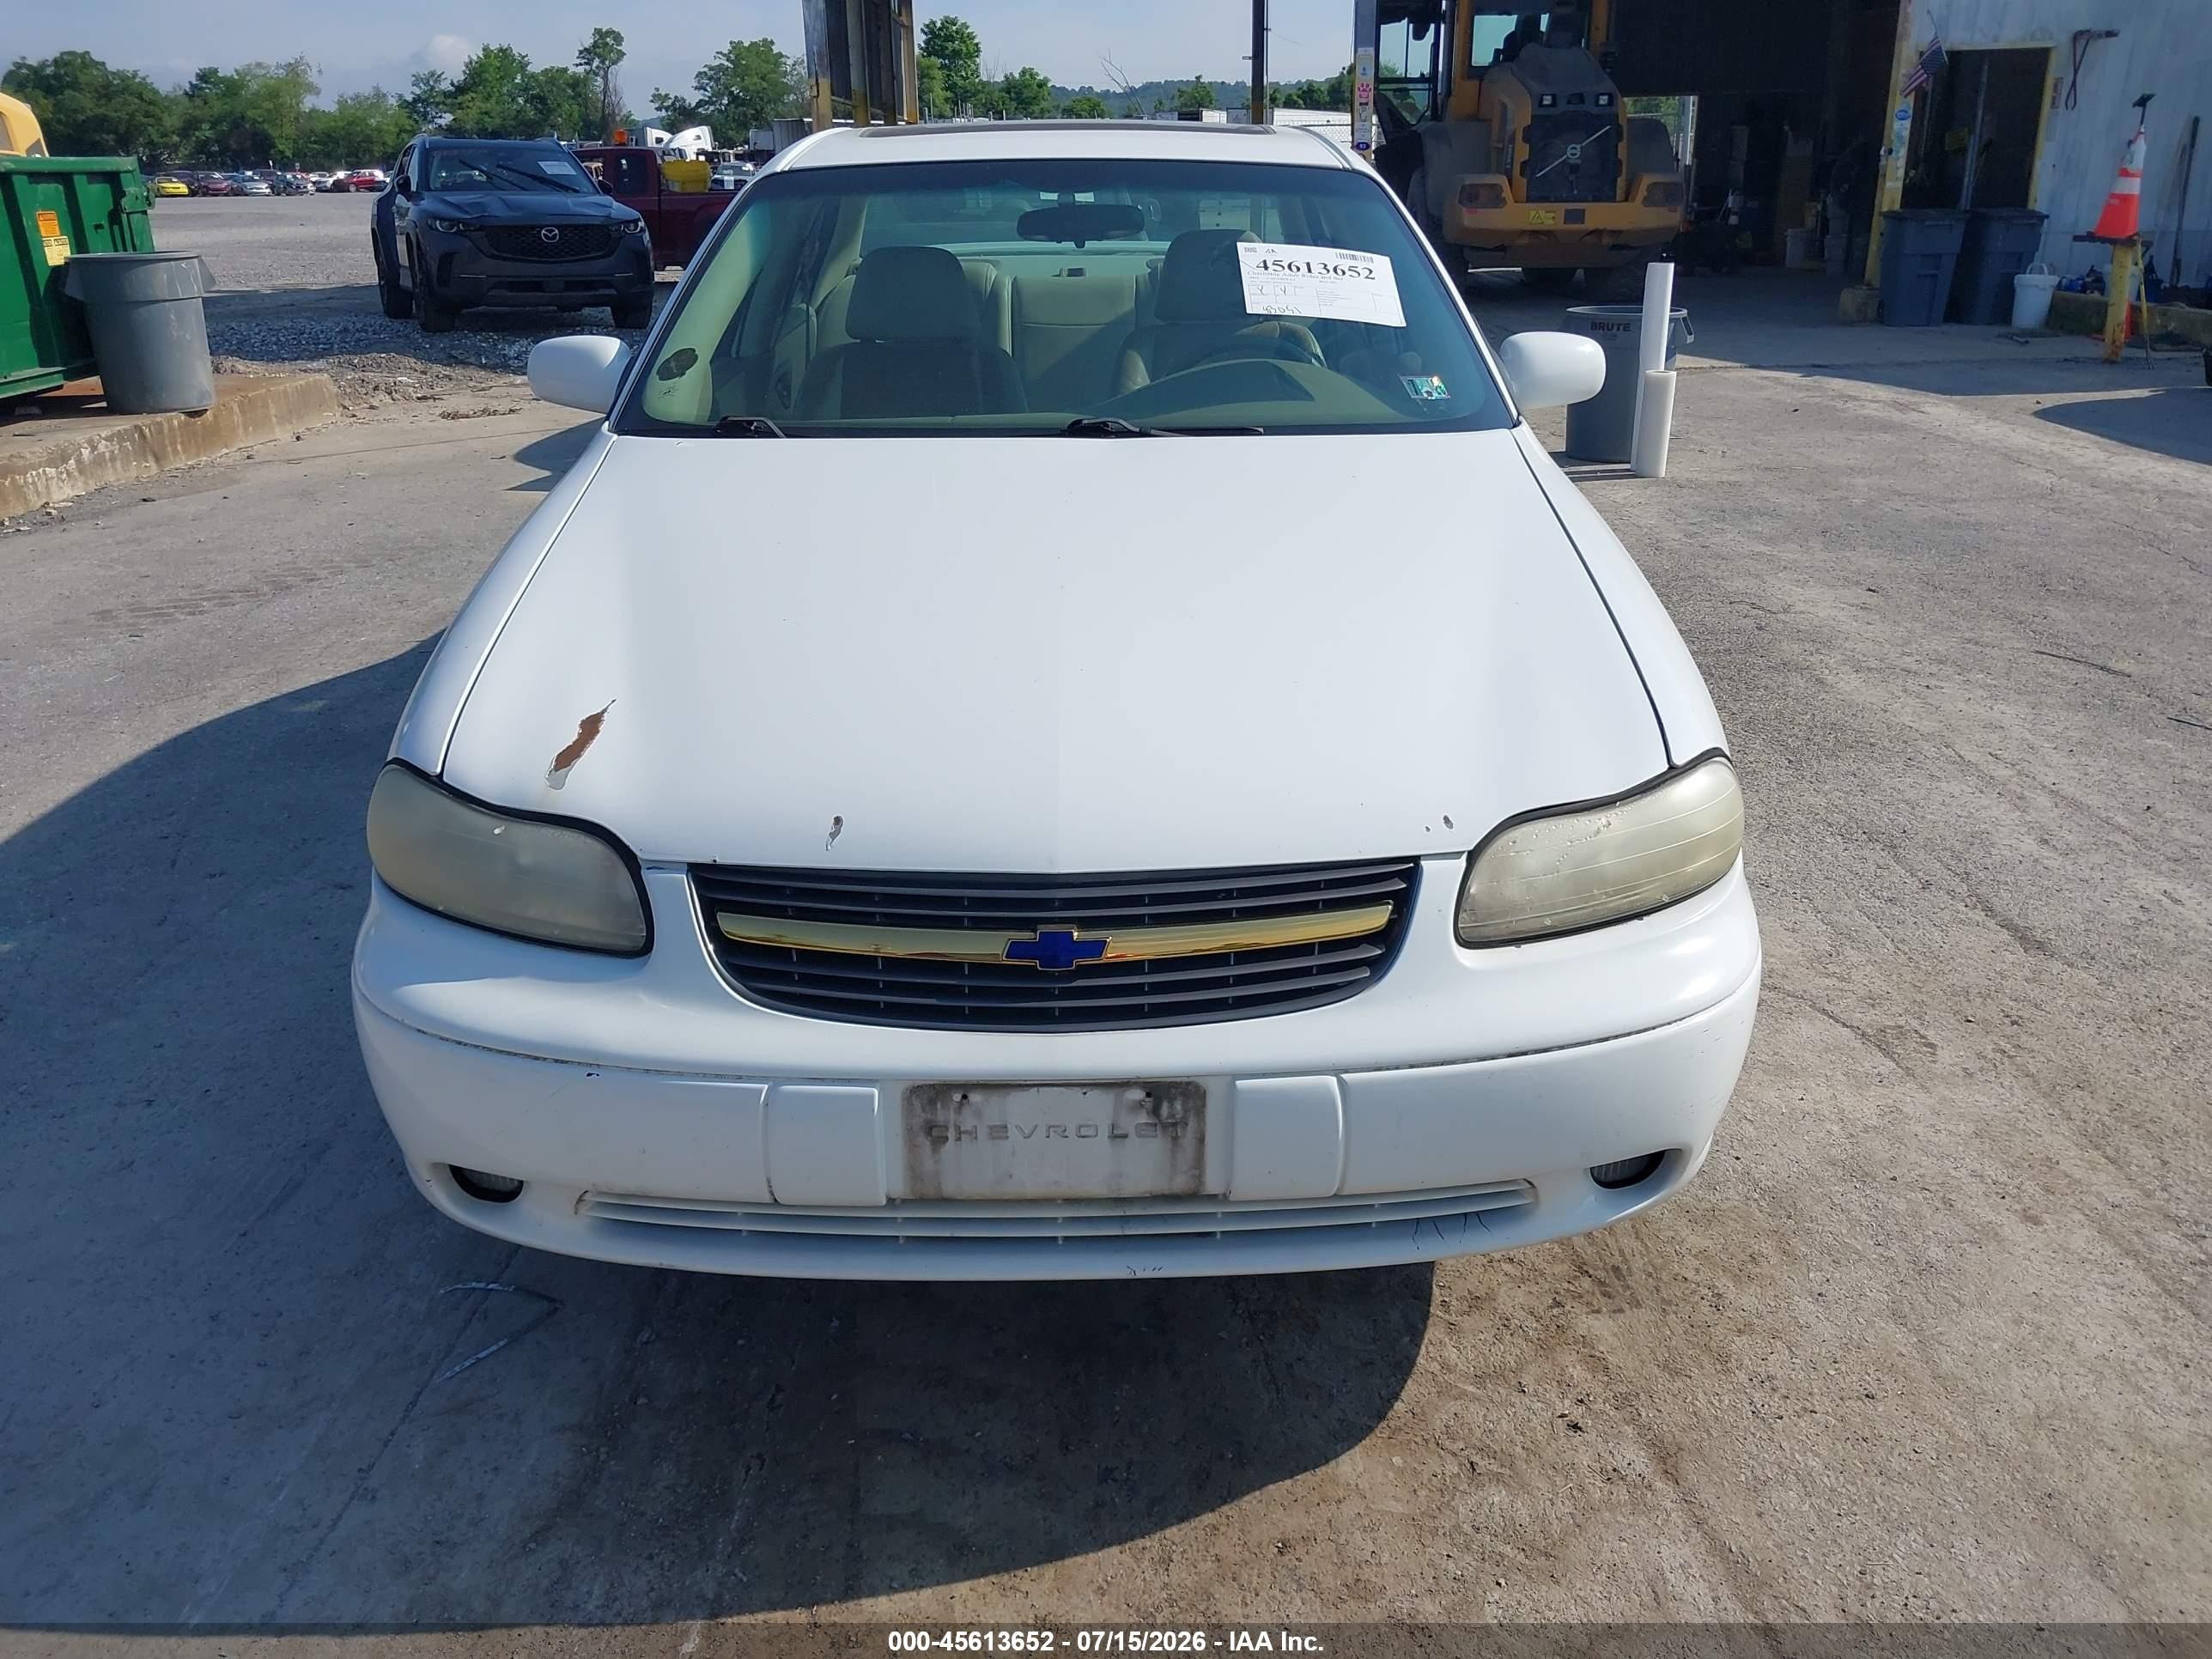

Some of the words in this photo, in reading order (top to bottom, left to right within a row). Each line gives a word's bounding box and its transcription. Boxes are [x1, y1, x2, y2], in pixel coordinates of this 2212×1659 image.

[1255, 258, 1376, 281] 45613652
[1590, 322, 1632, 331] BRUTE
[927, 1121, 1188, 1142] CHEVROLET
